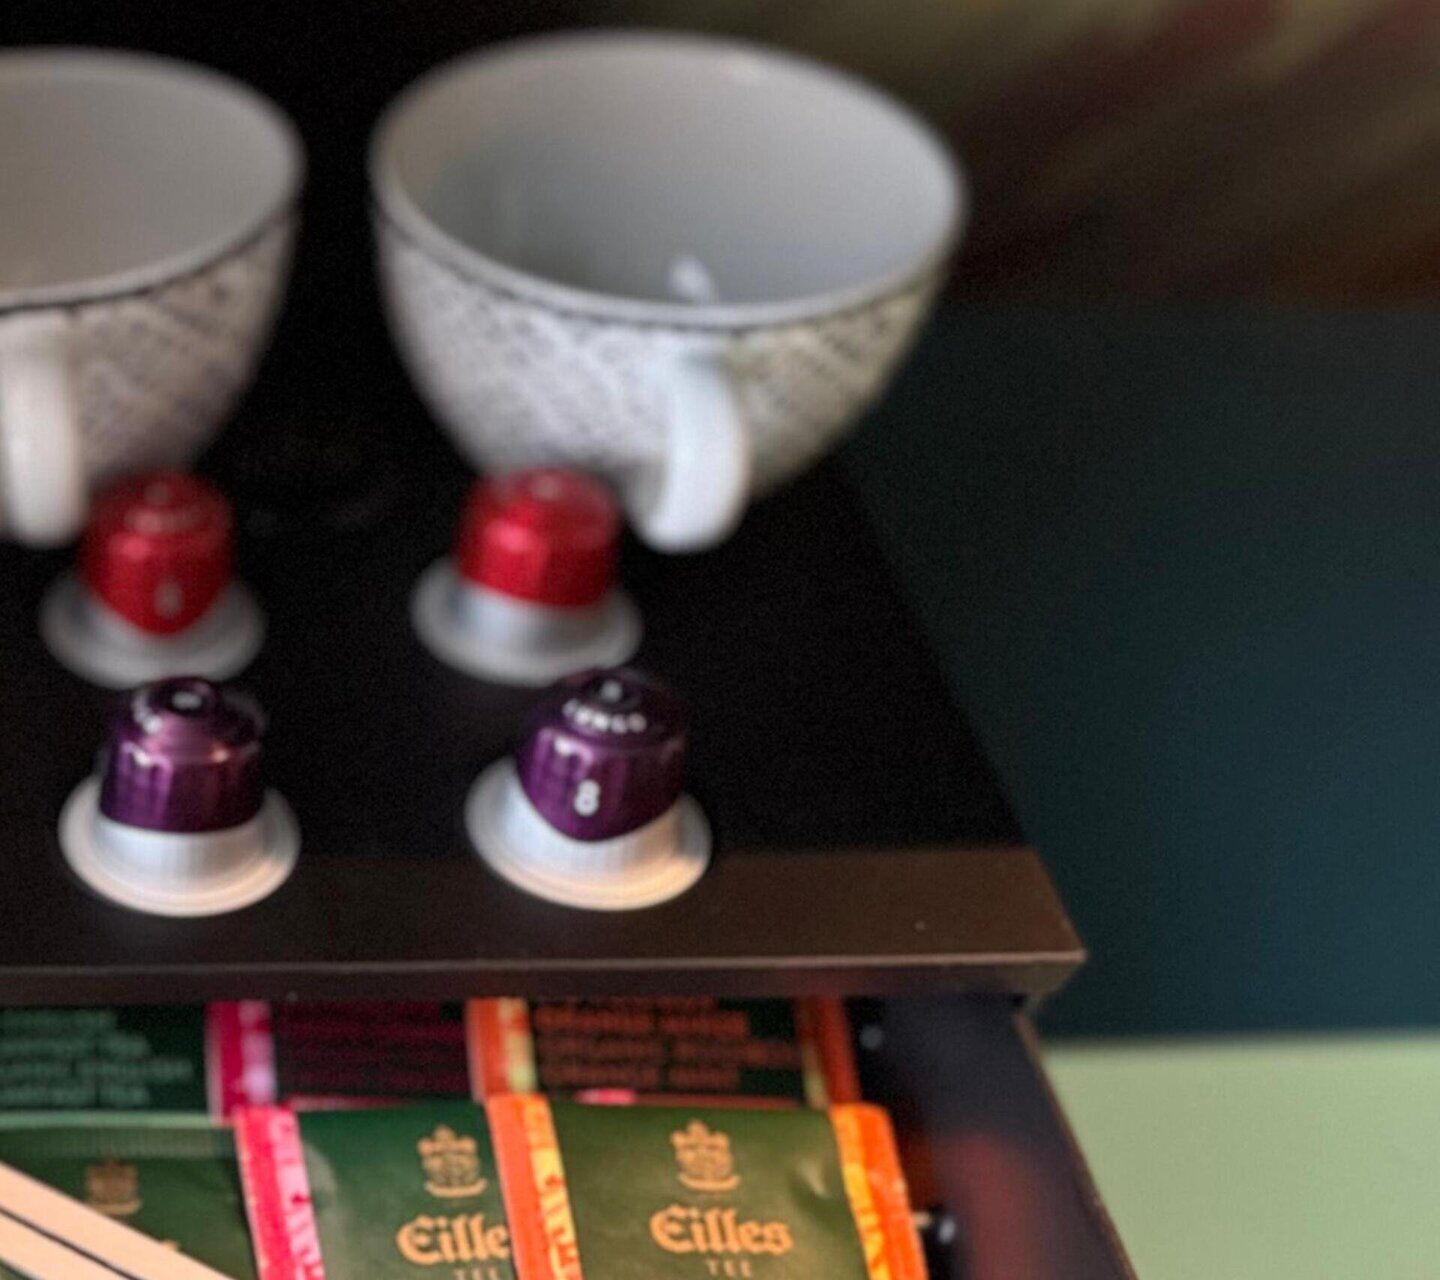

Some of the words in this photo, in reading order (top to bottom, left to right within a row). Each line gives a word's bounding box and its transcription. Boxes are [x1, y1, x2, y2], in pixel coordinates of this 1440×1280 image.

[574, 779, 600, 817] 8
[650, 1204, 793, 1254] Eilles
[707, 1260, 752, 1278] TEE
